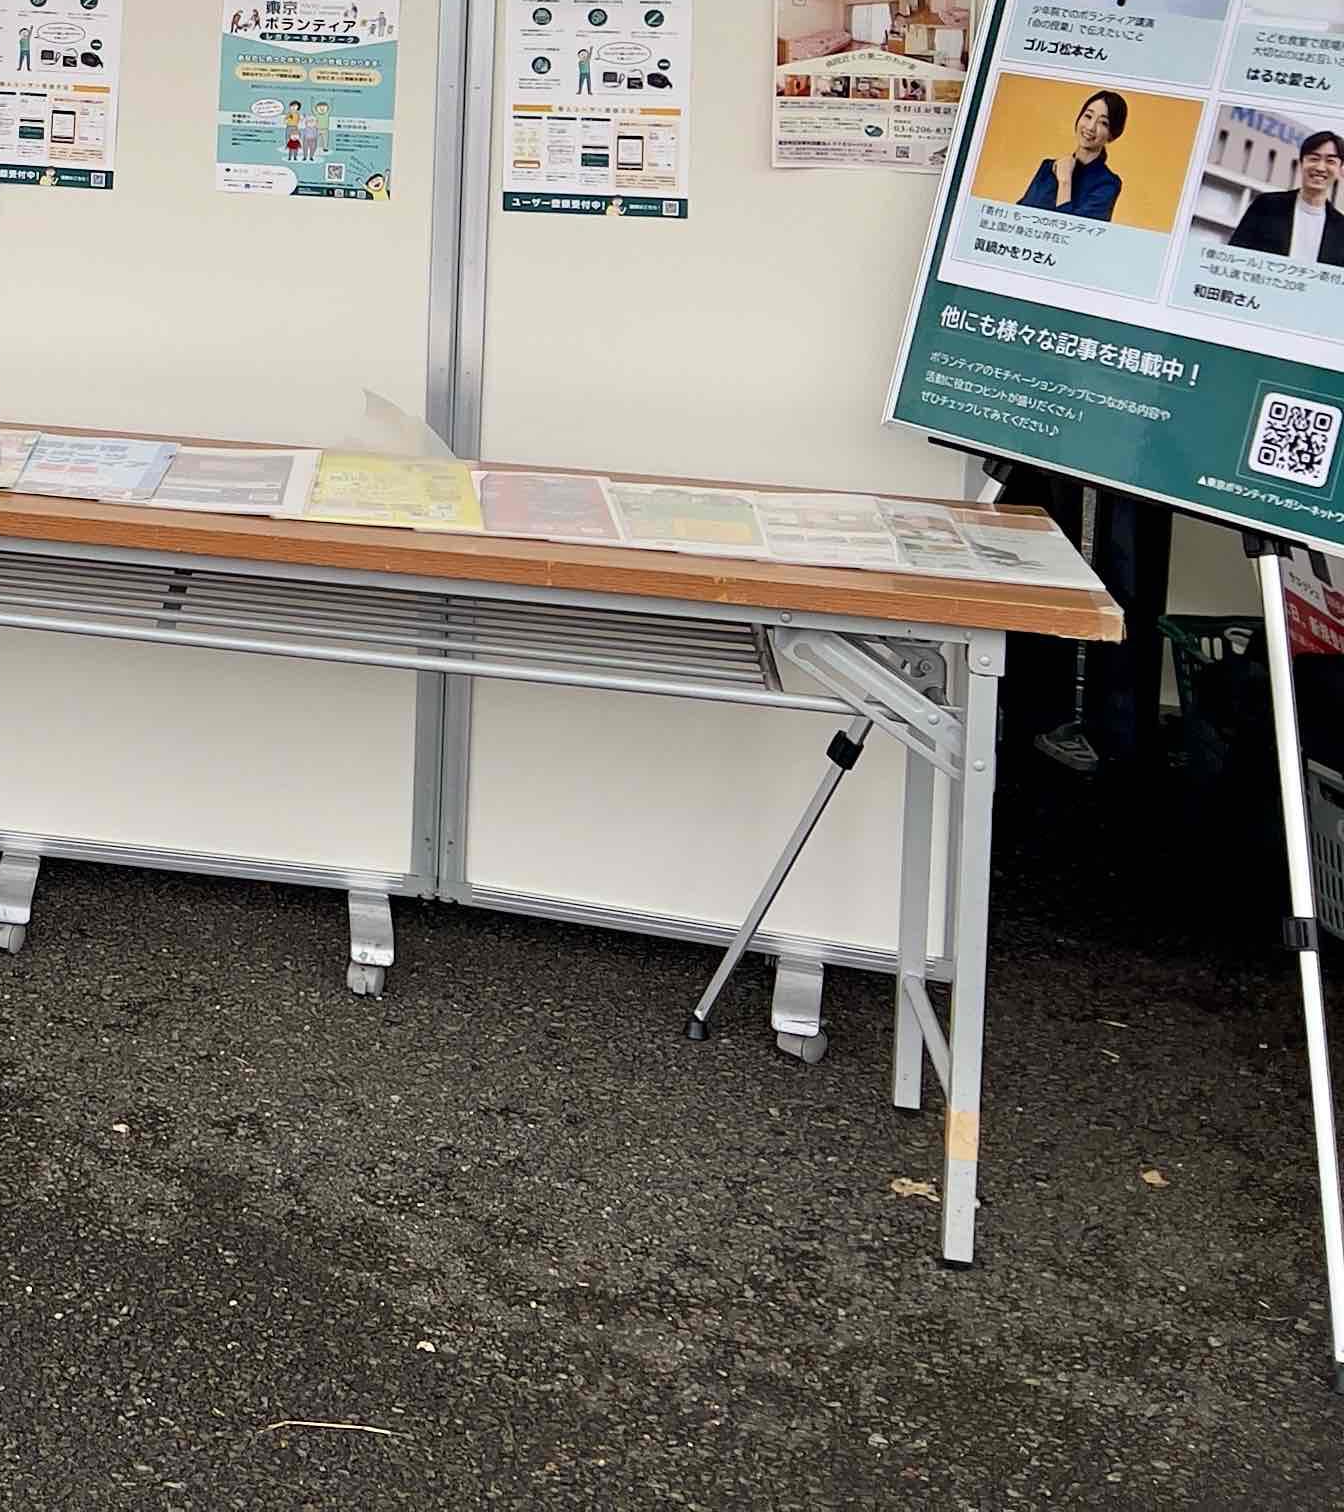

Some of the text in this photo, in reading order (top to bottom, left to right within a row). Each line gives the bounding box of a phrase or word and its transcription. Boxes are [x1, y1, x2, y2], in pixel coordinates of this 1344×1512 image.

[265, 0, 298, 15] 東京
[264, 17, 357, 33] ボランティア
[1023, 38, 1109, 61] ゴルゴ松本さん
[1246, 67, 1331, 90] はるな愛さん
[940, 304, 1201, 387] 他にも様々な記事を掲載中！
